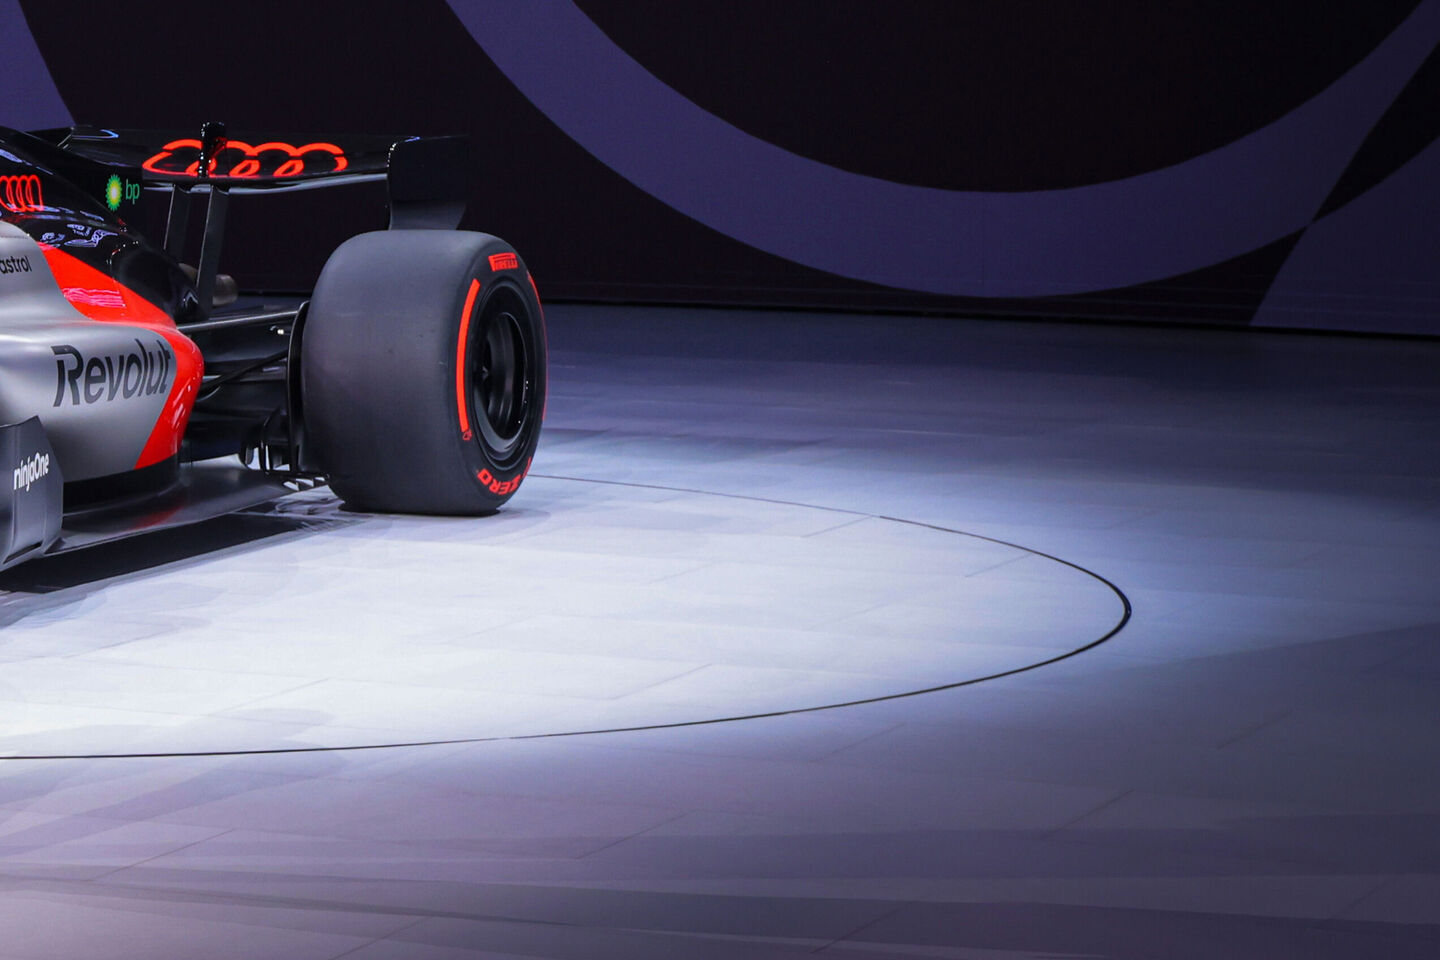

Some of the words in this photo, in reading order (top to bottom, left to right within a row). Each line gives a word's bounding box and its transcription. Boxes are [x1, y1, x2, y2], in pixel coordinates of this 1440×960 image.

[125, 178, 140, 205] bp
[50, 337, 171, 407] Revolut
[13, 452, 50, 492] ninjaOne
